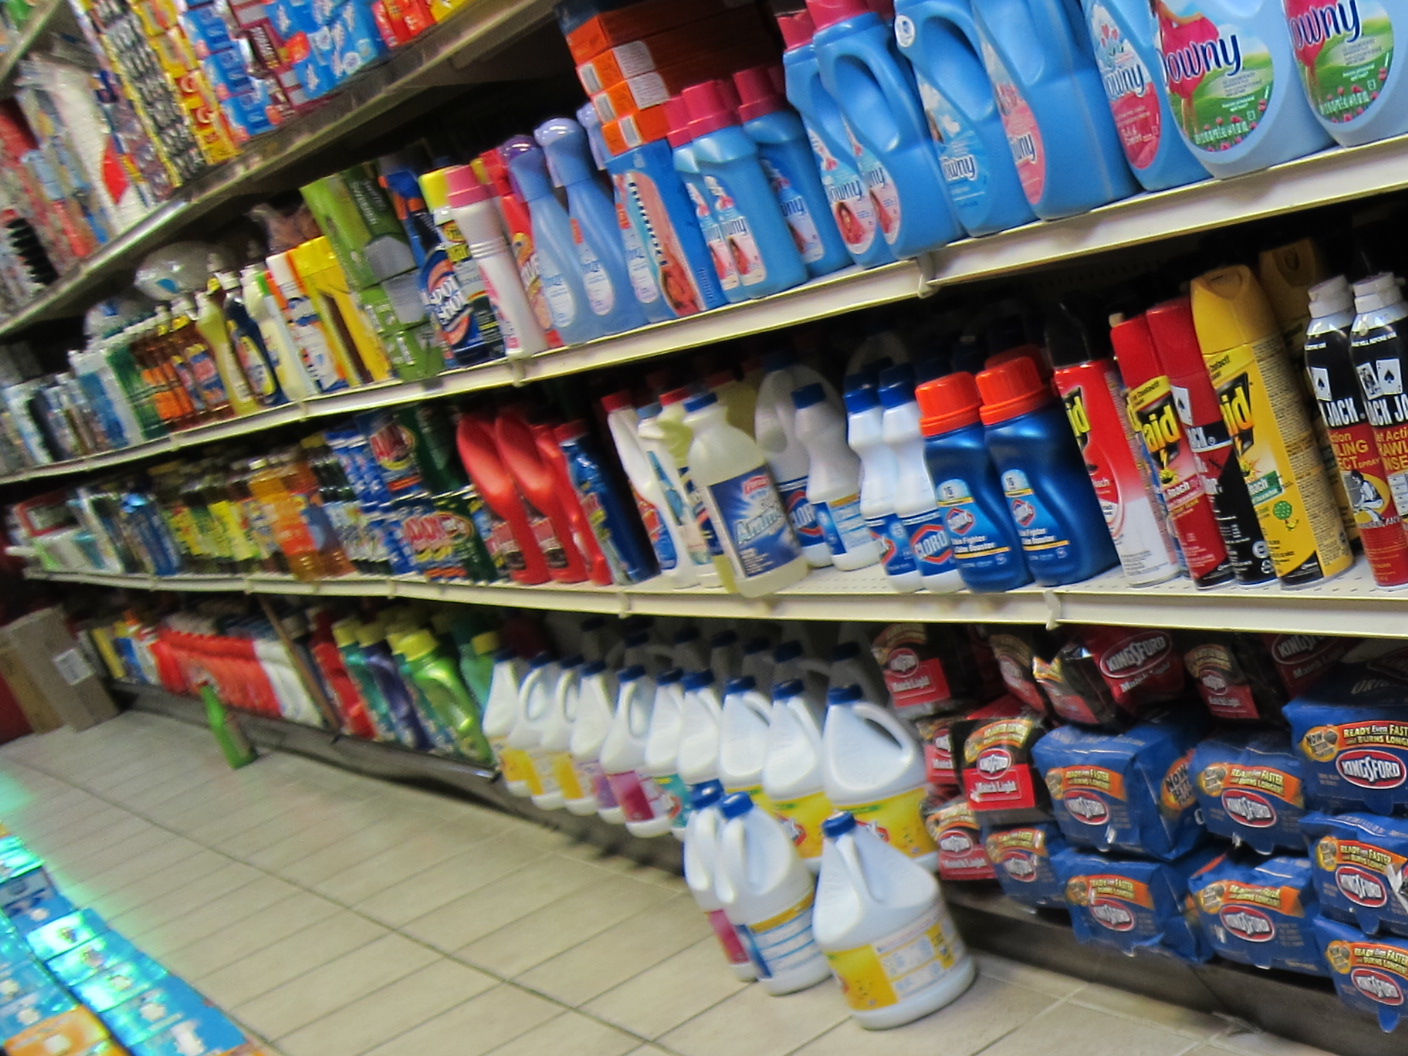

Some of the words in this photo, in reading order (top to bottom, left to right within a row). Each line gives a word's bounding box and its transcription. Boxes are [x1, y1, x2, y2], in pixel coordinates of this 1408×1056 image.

[1290, 0, 1363, 48] owny
[1105, 62, 1146, 99] owny
[1065, 395, 1091, 438] id
[1220, 384, 1255, 438] id
[1327, 397, 1360, 428] JACK
[1366, 399, 1393, 427] ACK
[1142, 403, 1182, 453] aid
[1330, 431, 1352, 443] tion
[1335, 439, 1369, 454] LING
[914, 529, 950, 560] CLORO
[1105, 635, 1167, 673] KINGSFORD
[1343, 726, 1372, 739] READY
[1357, 735, 1385, 745] BURNS
[1165, 763, 1191, 793] NOW
[1341, 755, 1402, 783] KINGSFORD
[1368, 849, 1393, 864] FASTER
